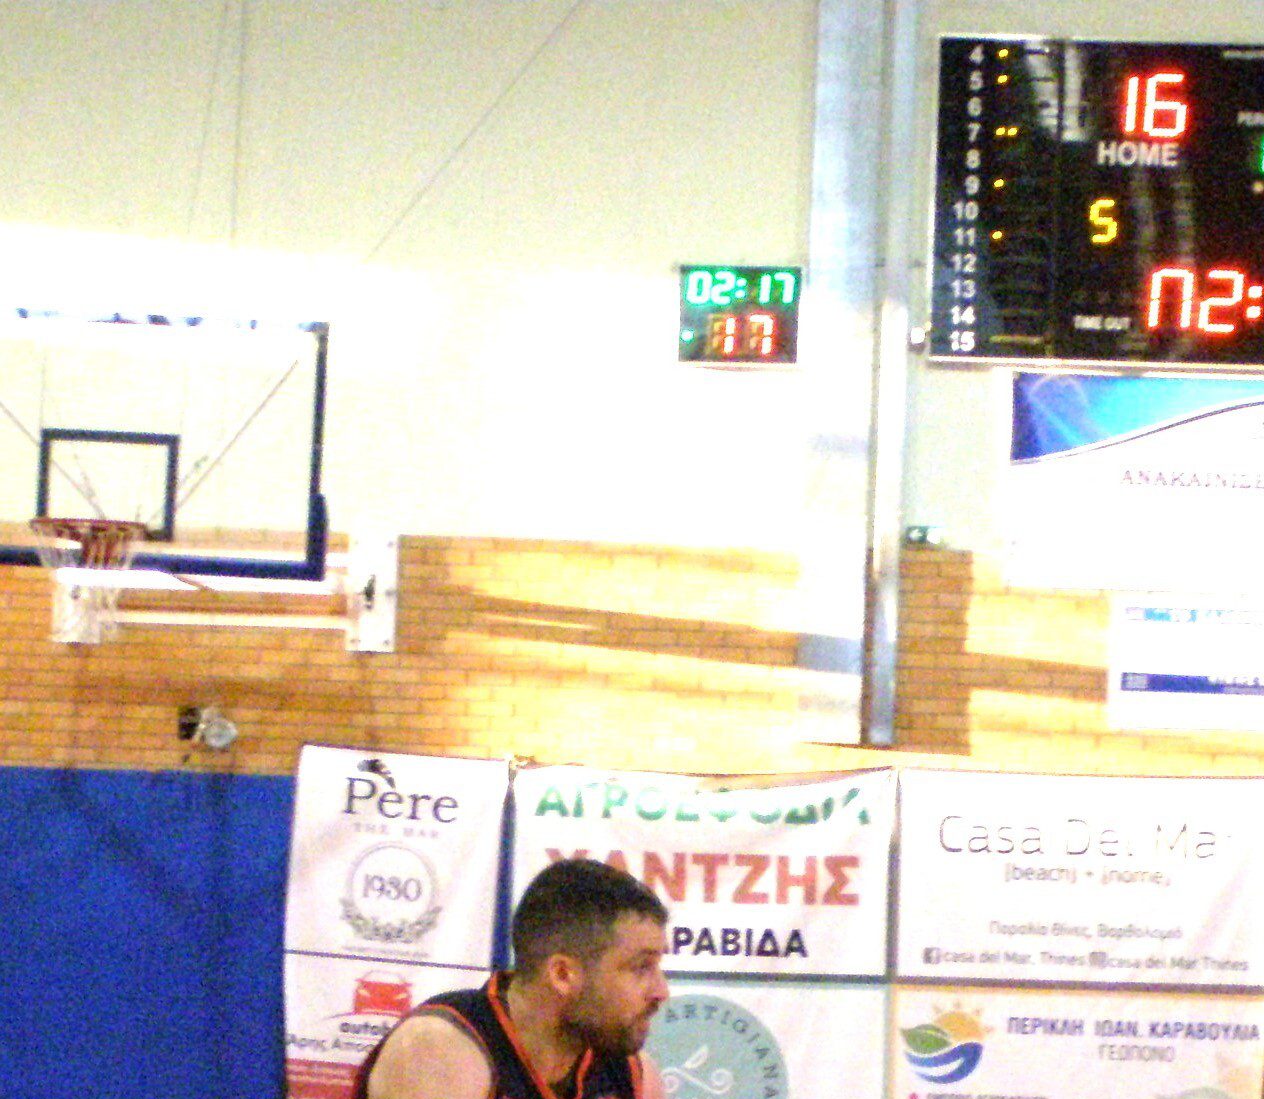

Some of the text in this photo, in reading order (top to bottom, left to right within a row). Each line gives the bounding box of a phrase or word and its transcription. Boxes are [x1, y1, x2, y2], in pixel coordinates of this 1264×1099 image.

[969, 44, 984, 64] 4
[970, 70, 983, 91] 5
[967, 97, 982, 117] 6
[1124, 73, 1188, 137] 16
[968, 122, 981, 143] 7
[966, 149, 981, 169] 8
[1098, 142, 1179, 166] HOME
[965, 175, 980, 195] 9
[953, 200, 979, 221] 10
[1089, 199, 1118, 243] 5
[954, 227, 976, 247] 11
[952, 253, 977, 273] 12
[685, 270, 796, 305] 02:17
[952, 279, 976, 299] 13
[951, 305, 976, 325] 14
[950, 331, 976, 352] 15
[939, 815, 1233, 860] Casa De Ma
[362, 873, 423, 902] 1930
[664, 926, 809, 959] ΡΑΒΙΔΑ
